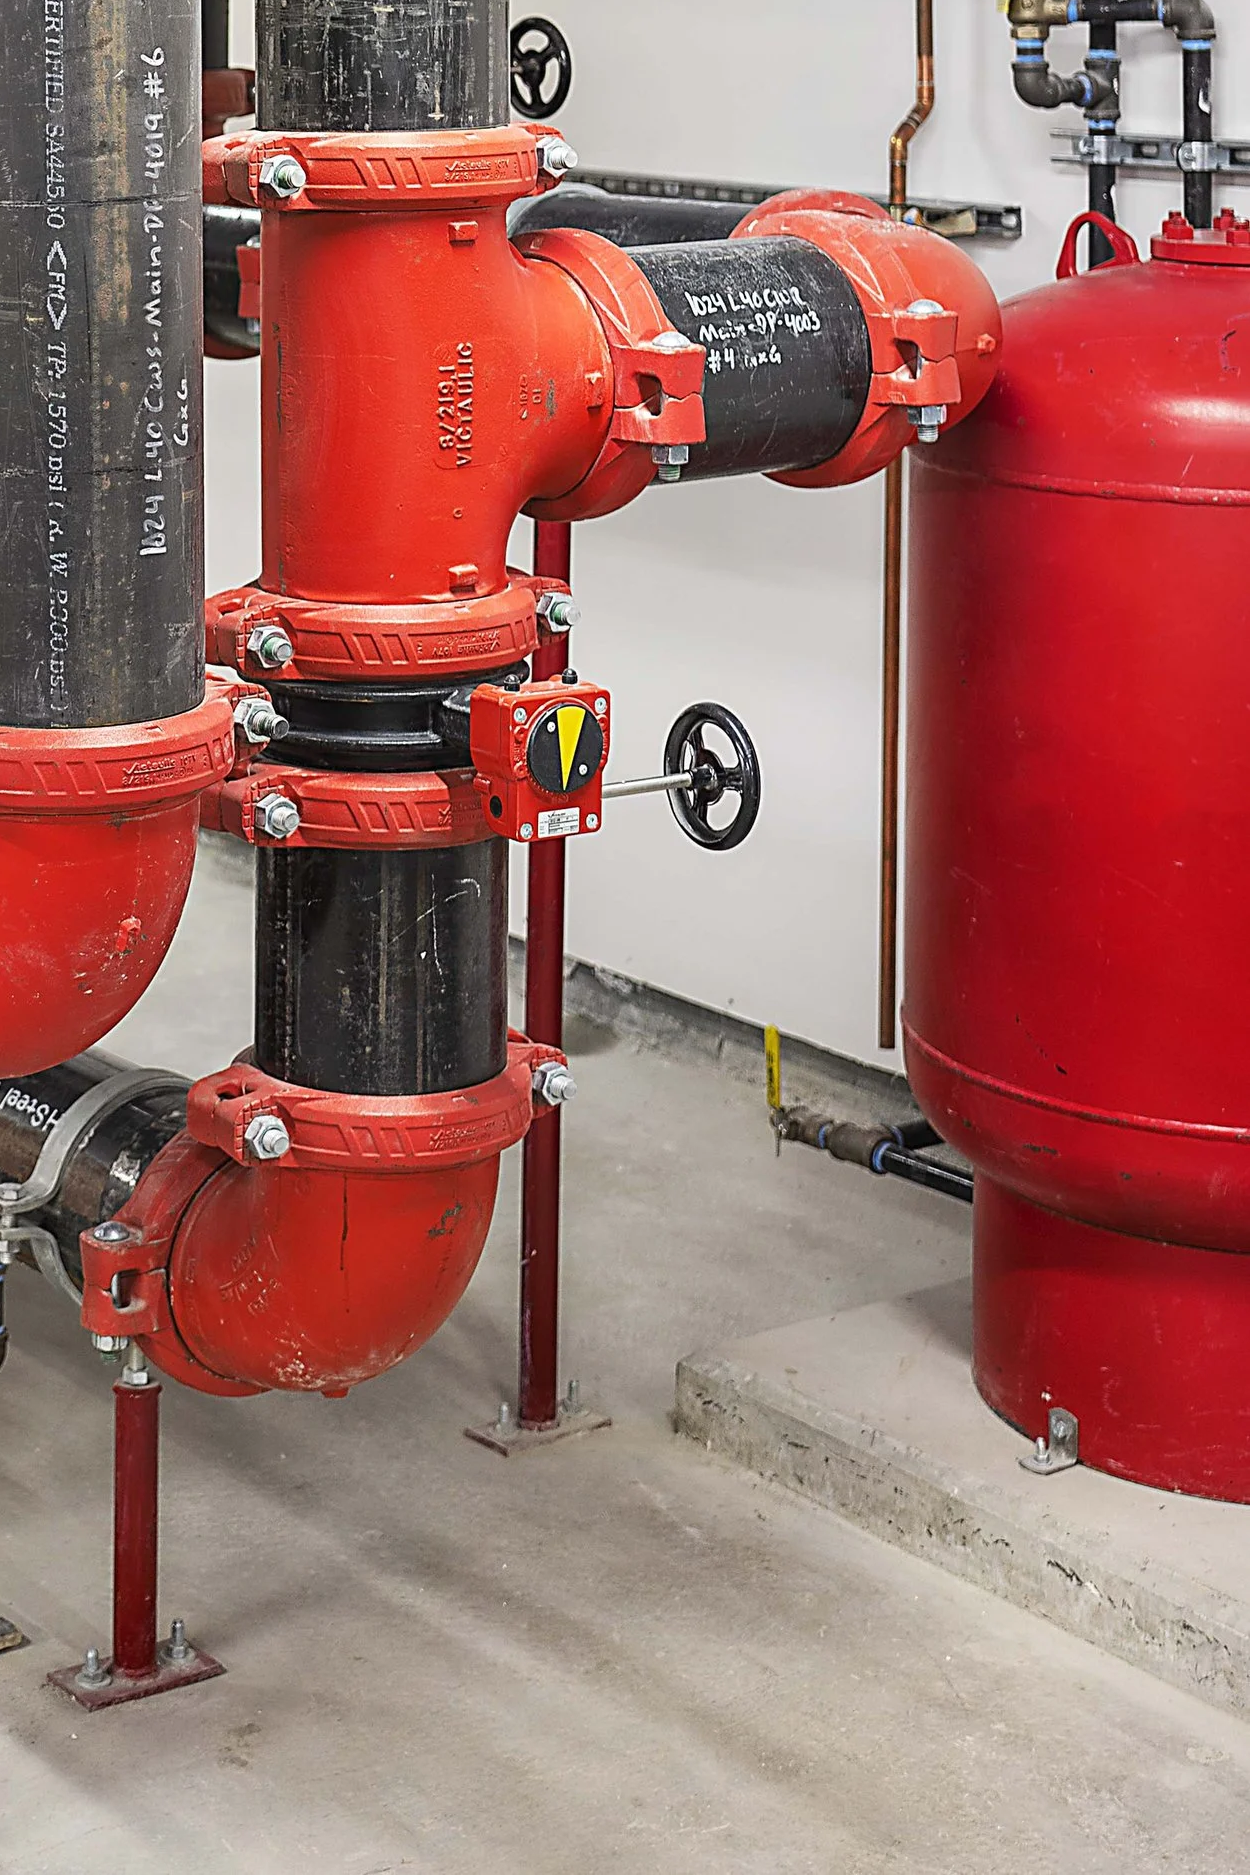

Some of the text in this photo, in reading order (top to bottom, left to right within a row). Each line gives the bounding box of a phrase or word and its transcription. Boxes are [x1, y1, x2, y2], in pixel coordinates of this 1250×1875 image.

[684, 291, 727, 317] 1024
[47, 389, 67, 450] 1570
[455, 341, 475, 467] VICTAULIC
[138, 493, 168, 557] 1024
